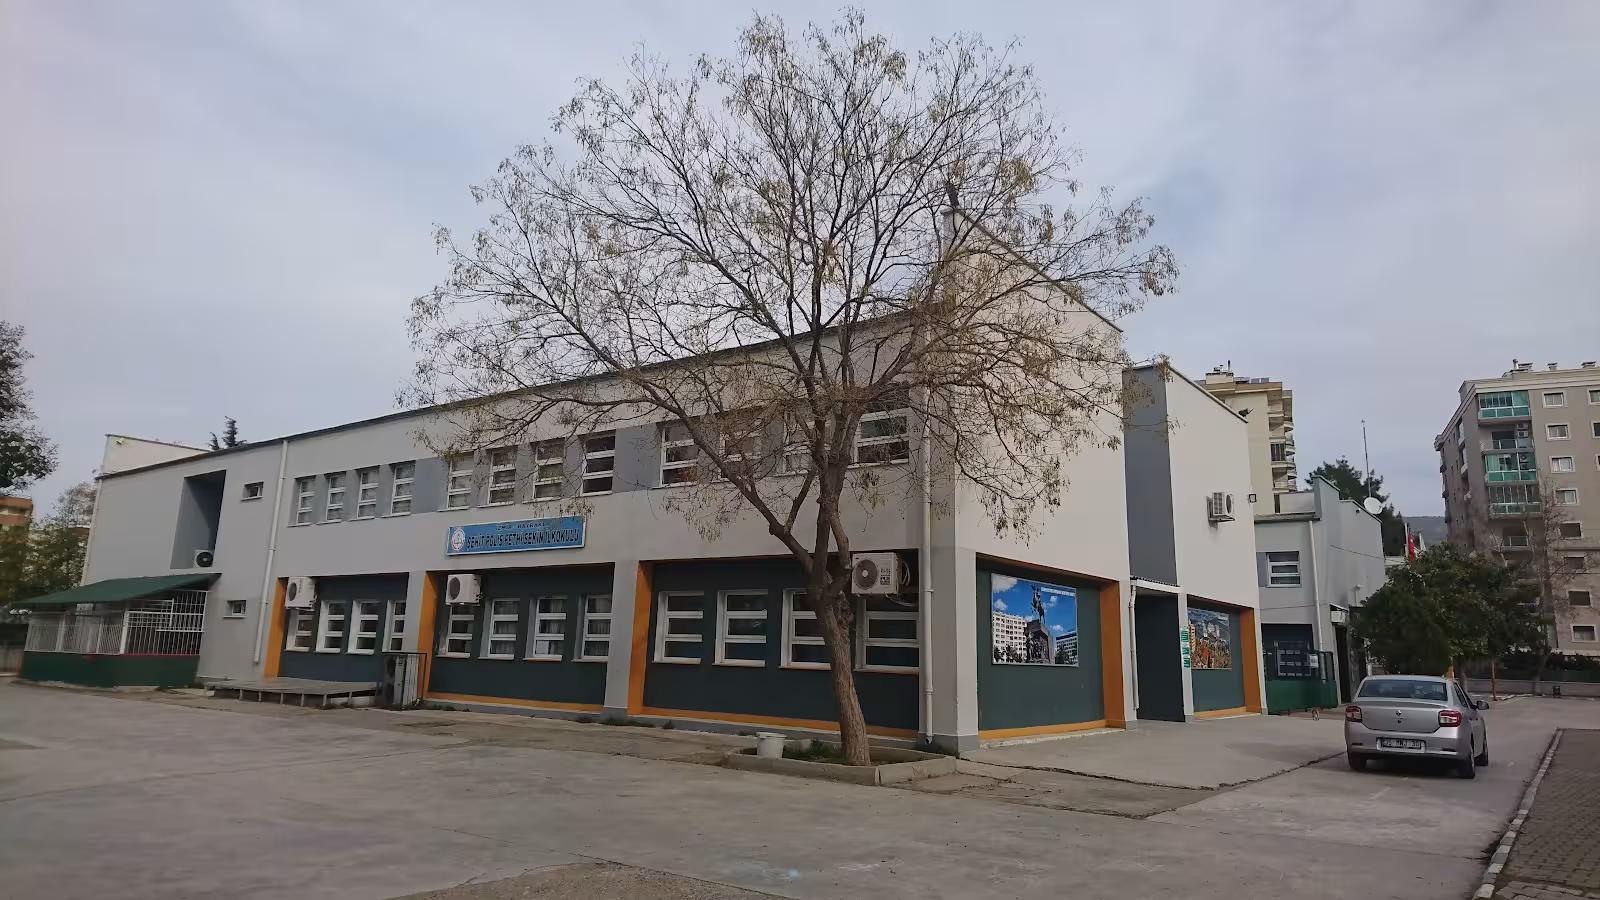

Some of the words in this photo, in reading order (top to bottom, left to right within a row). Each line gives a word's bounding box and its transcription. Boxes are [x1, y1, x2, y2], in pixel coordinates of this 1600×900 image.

[467, 533, 484, 549] ŞEHİT
[486, 533, 503, 547] POLİS
[504, 531, 523, 546] FETHİ
[523, 529, 543, 545] SEKİN
[544, 528, 579, 544] İLKOKULU
